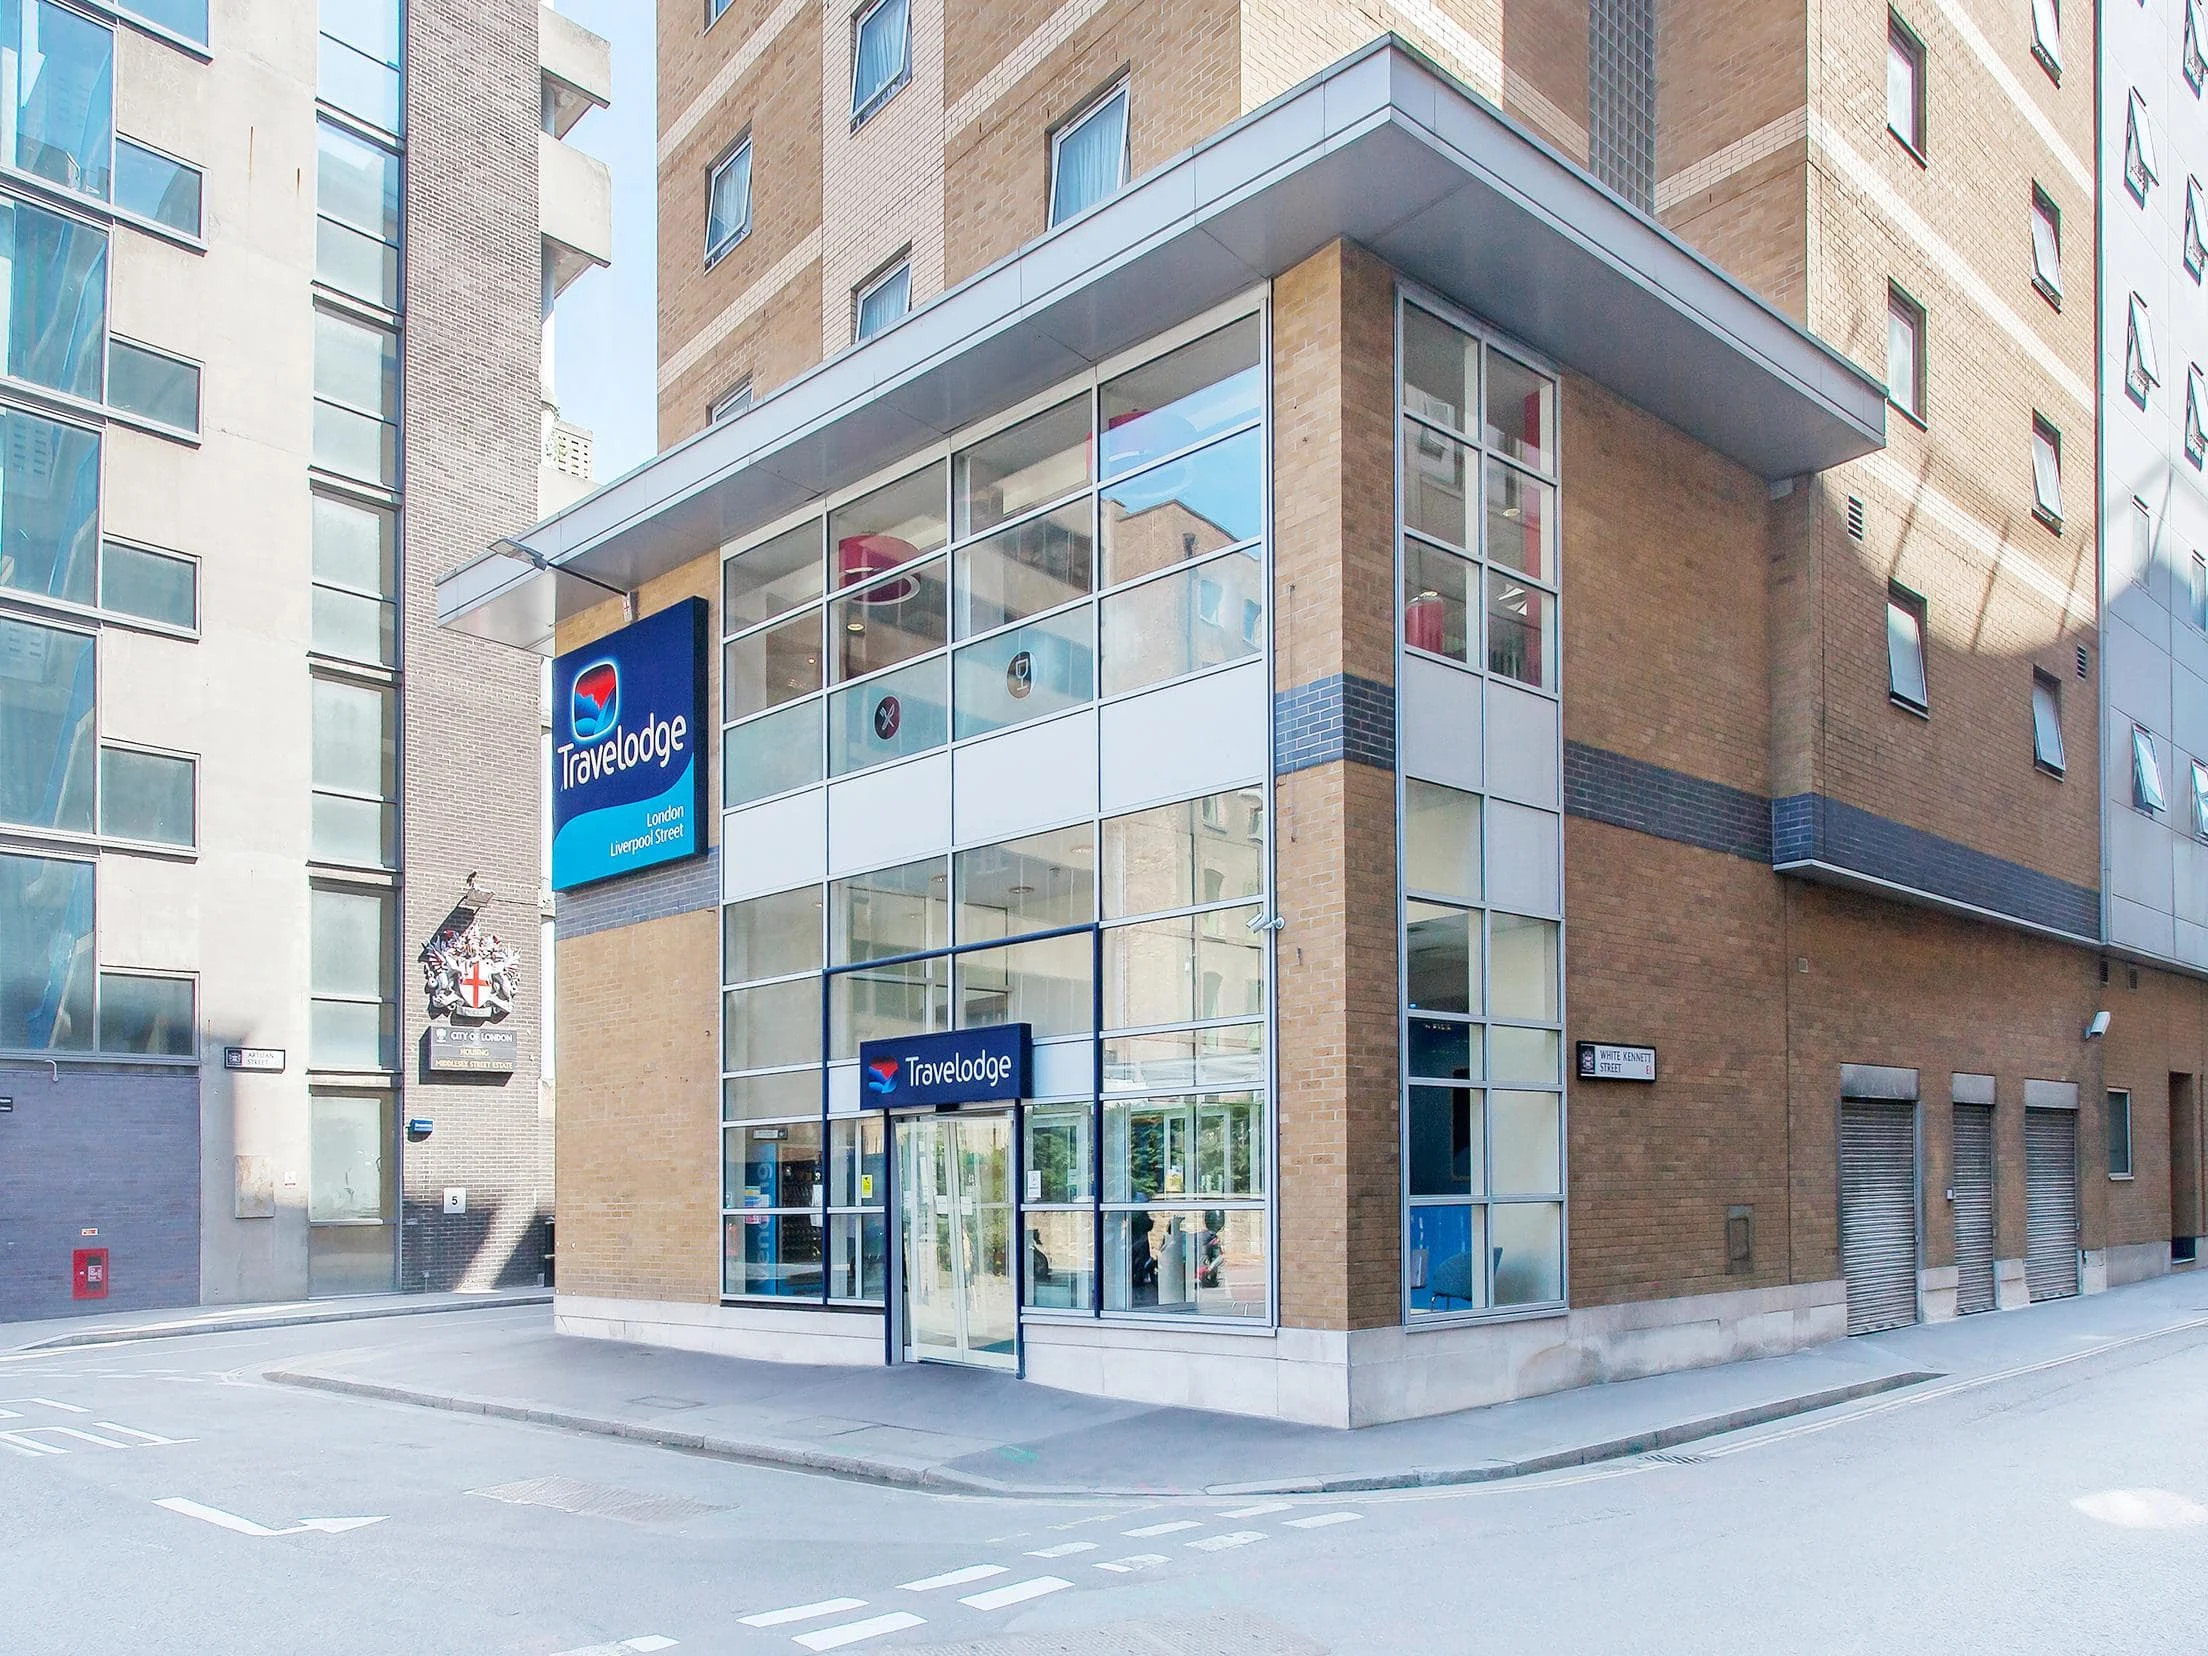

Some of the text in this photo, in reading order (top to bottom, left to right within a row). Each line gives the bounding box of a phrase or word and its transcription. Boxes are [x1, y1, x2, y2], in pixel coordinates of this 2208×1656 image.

[557, 712, 687, 790] Travelodge
[647, 804, 684, 826] London
[611, 824, 684, 857] Liverpool Street
[450, 1032, 468, 1040] CITY
[481, 1033, 512, 1042] LONDON
[1600, 1050, 1652, 1062] WHITE KENNETT
[905, 1049, 1012, 1087] Travelodge
[1600, 1062, 1622, 1072] STREET
[451, 1195, 458, 1206] 5
